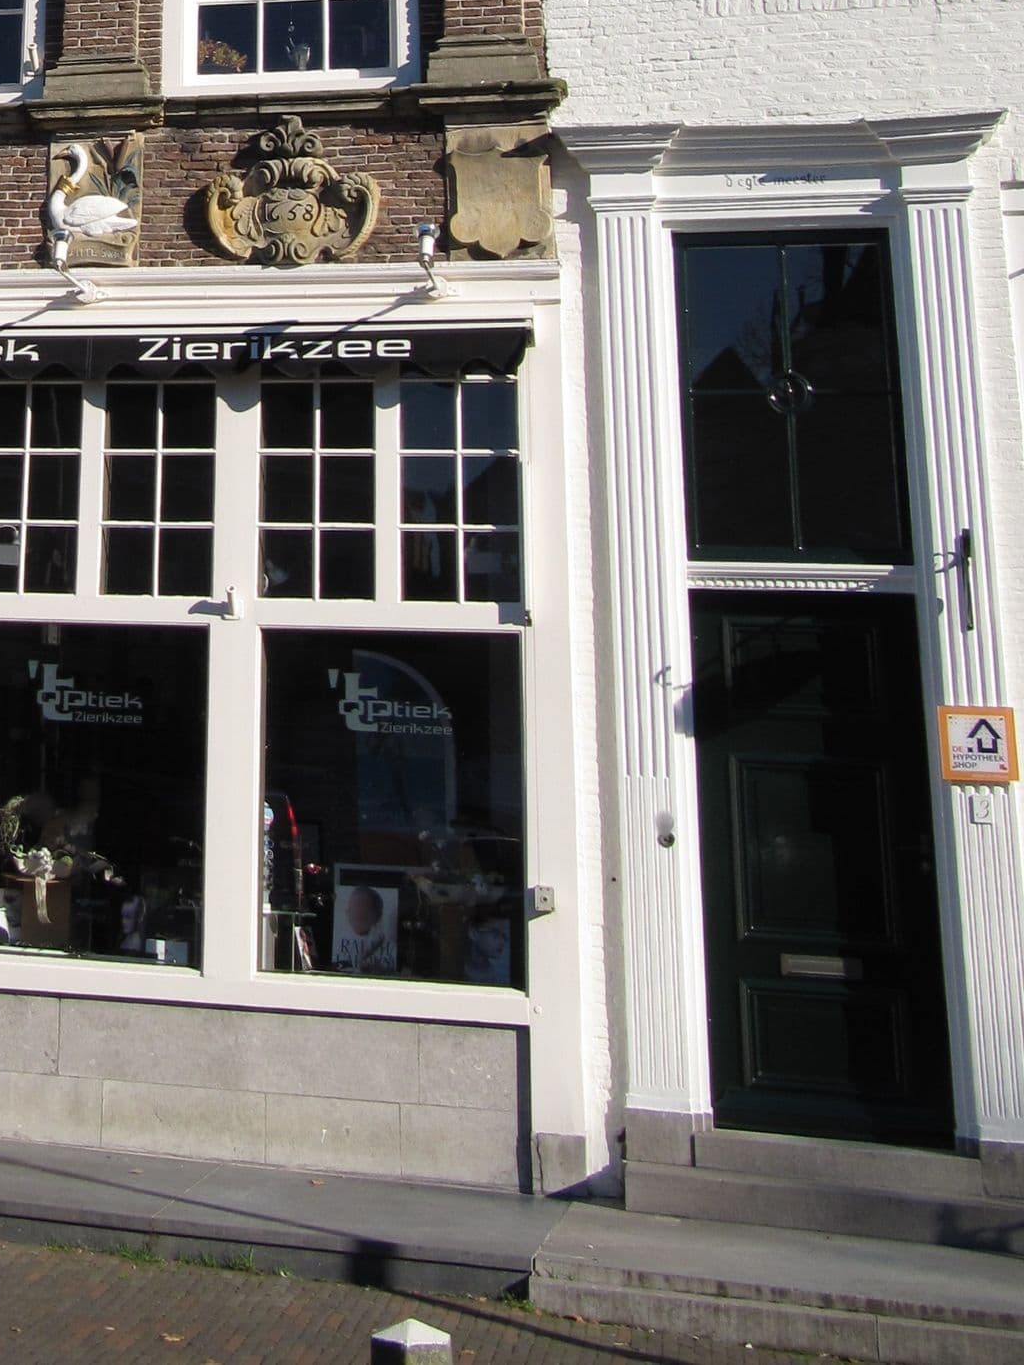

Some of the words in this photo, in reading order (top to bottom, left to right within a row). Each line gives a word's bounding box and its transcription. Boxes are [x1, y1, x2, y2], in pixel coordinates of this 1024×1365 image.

[264, 202, 314, 222] 1658
[138, 335, 412, 363] Zierikzee
[73, 711, 144, 724] Zierikzee
[377, 721, 454, 736] Zierikzee
[952, 753, 1006, 763] HYPOTHEEK
[952, 761, 978, 769] SHOP
[975, 799, 990, 819] 3
